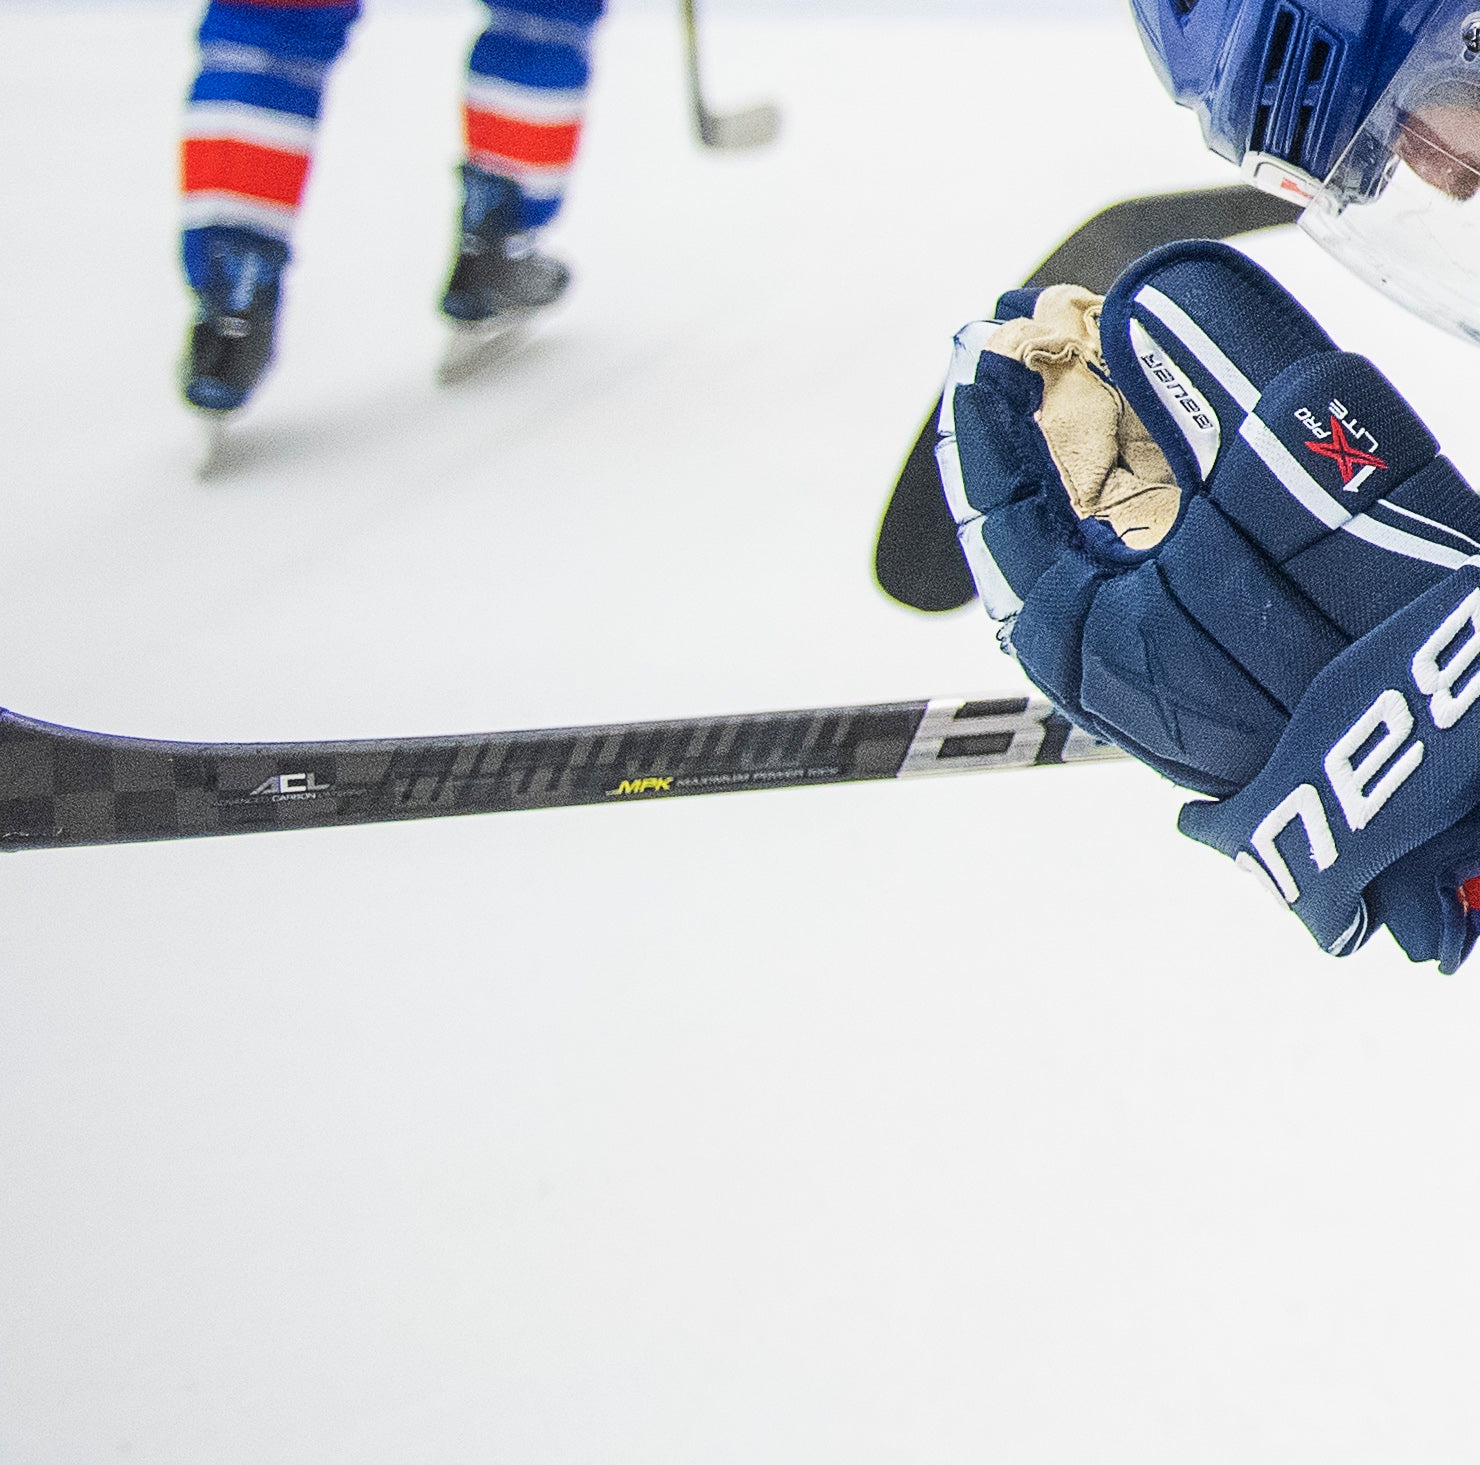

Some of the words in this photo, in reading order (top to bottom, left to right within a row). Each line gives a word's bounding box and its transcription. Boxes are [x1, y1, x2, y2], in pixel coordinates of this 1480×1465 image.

[1140, 353, 1214, 430] BAUER
[1293, 407, 1332, 439] PRO
[1328, 398, 1379, 453] LITE
[250, 772, 330, 795] ACL
[616, 777, 674, 794] MPK
